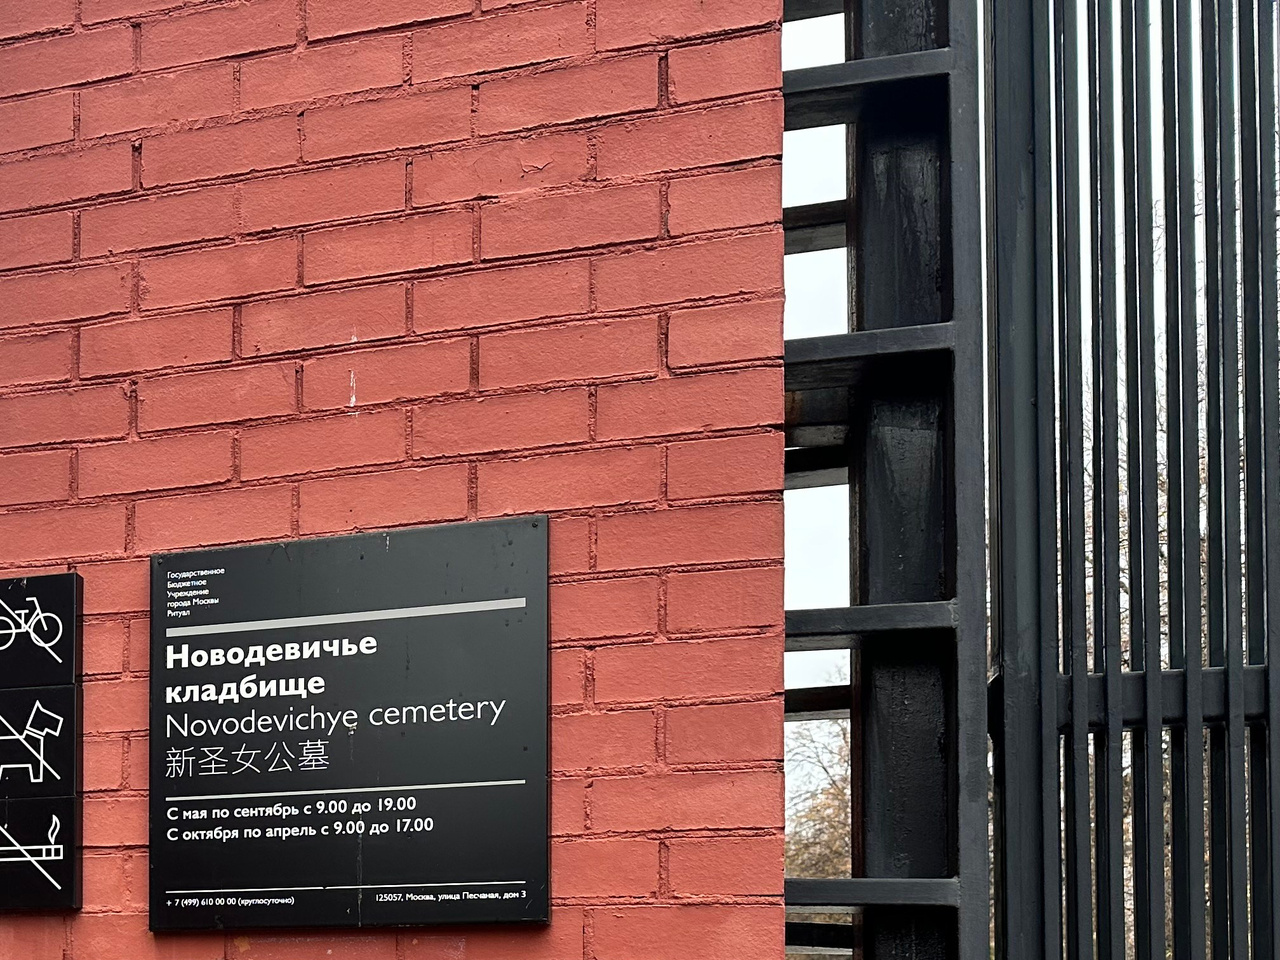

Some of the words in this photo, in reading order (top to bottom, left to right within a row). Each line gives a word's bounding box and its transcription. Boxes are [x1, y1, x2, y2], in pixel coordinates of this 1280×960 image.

[167, 568, 225, 579] Государственное
[167, 580, 207, 588] Бюджетное
[166, 589, 209, 599] Учреждение
[167, 600, 191, 608] города
[167, 610, 190, 618] Ритуал
[166, 635, 378, 669] Новодевичье
[165, 674, 326, 703] кладбище
[166, 705, 358, 739] Novodevichye
[368, 699, 507, 728] cemetery
[165, 738, 330, 778] 新圣女公墓
[166, 807, 178, 820] С
[182, 808, 208, 820] мая
[211, 807, 230, 819] по
[233, 803, 299, 819] сентябрь
[303, 804, 312, 815] с
[315, 799, 348, 814] 9.00
[351, 801, 372, 815] до
[378, 796, 417, 812] 19.00
[166, 828, 179, 841] С
[182, 826, 239, 842] октября
[243, 827, 262, 838] по
[265, 824, 317, 840] апрель
[320, 824, 329, 835] с
[333, 820, 365, 835] 9.00
[369, 822, 390, 836] до
[396, 817, 434, 833] 17.00
[181, 898, 199, 907] (499)
[215, 897, 225, 905] 00
[227, 897, 236, 905] 00
[238, 896, 295, 906] (круглосуточно)
[376, 893, 404, 902] 125057,
[406, 892, 436, 901] Москва,
[438, 893, 460, 901] улица
[462, 891, 501, 900] Песчаная,
[520, 890, 527, 898] 3
